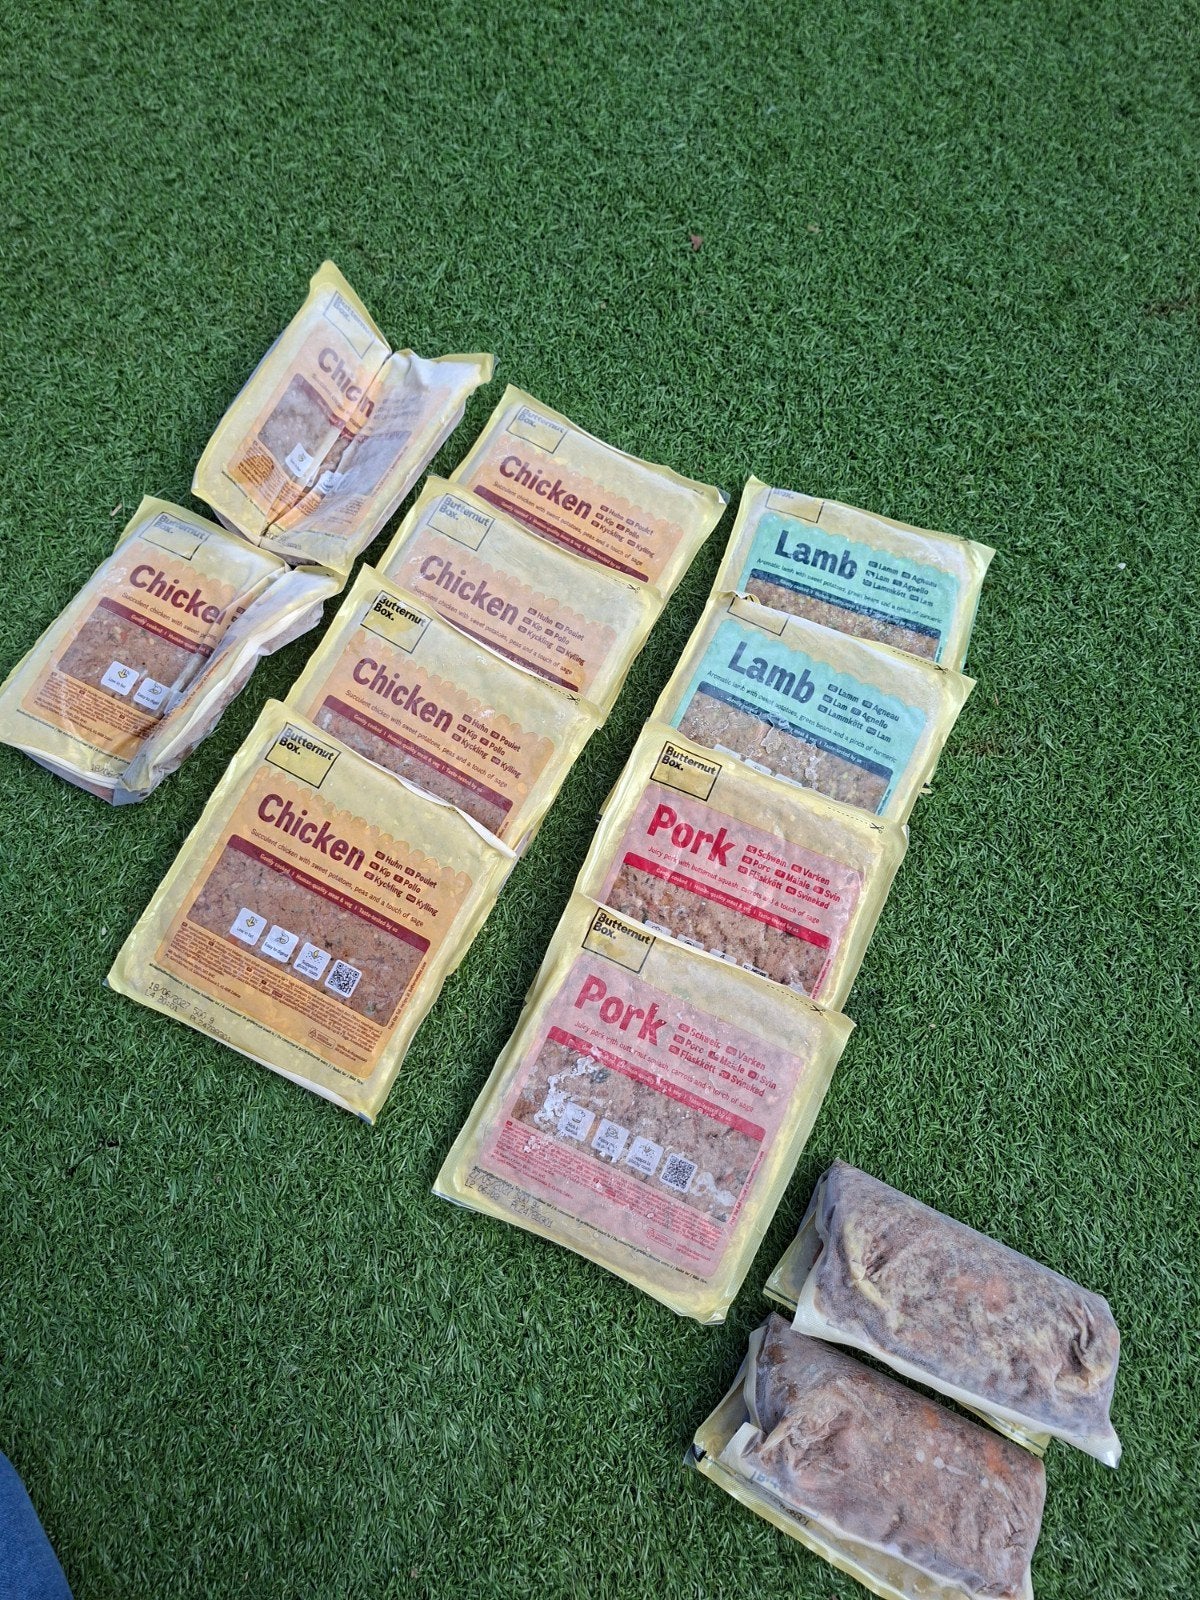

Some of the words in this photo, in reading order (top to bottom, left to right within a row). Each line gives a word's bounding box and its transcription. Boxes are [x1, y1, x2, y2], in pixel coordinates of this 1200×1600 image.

[317, 347, 375, 418] Chicn
[499, 455, 592, 519] Chicken
[438, 504, 461, 520] Box.
[443, 496, 490, 527] Butternut
[603, 516, 615, 527] Kip
[598, 523, 625, 542] Kyckling
[774, 530, 858, 579] Lamb
[878, 563, 899, 575] Lamm
[418, 555, 519, 626] Chicken
[148, 606, 171, 620] chicken
[373, 602, 397, 620] Box.
[377, 594, 427, 627] Butternut
[525, 629, 554, 649] Kyckling
[563, 649, 586, 667] Kylling
[530, 620, 544, 632] Kip
[553, 632, 570, 645] Pollo
[563, 625, 585, 641] Poulet
[558, 665, 572, 676] sage
[727, 641, 815, 704] Lamb
[352, 657, 453, 733] Chicken
[837, 688, 859, 703] Lamm
[871, 704, 900, 723] Agneau
[746, 688, 759, 697] with
[815, 722, 833, 733] beans
[831, 729, 844, 738] and
[848, 737, 865, 749] pinch
[827, 708, 863, 730] Lammkött
[875, 731, 892, 742] Lam
[832, 698, 849, 711] Lam
[860, 712, 888, 730] Agnello
[278, 736, 304, 755] Box.
[283, 727, 335, 760] Butternut
[344, 689, 371, 708] Succulent
[370, 704, 391, 719] chicken
[389, 715, 402, 726] with
[401, 722, 417, 735] sweet
[441, 746, 455, 758] peas
[455, 753, 467, 763] and
[470, 762, 487, 775] touch
[492, 777, 508, 789] sage
[464, 729, 478, 741] Kip
[487, 742, 506, 756] Pollo
[470, 719, 490, 733] Huhn
[498, 735, 522, 752] Poulet
[459, 738, 489, 759] Kyckling
[498, 761, 522, 779] Kylling
[661, 754, 685, 771] Box.
[664, 745, 717, 775] Butternut
[258, 794, 366, 871] Chicken
[646, 803, 736, 866] Pork
[250, 828, 278, 847] Succulent
[277, 842, 299, 858] chicken
[298, 854, 311, 865] with
[310, 862, 328, 874] sweet
[327, 871, 355, 890] potatoes,
[353, 885, 368, 897] peas
[367, 893, 380, 903] and
[384, 902, 402, 914] touch
[401, 910, 410, 918] of
[409, 916, 424, 928] sage
[377, 865, 392, 878] Kip
[402, 879, 422, 893] Pollo
[384, 855, 404, 870] Huhn
[414, 871, 438, 888] Poulet
[647, 846, 663, 858] Juicy
[677, 859, 690, 868] with
[690, 864, 717, 880] butternut
[779, 902, 797, 914] touch
[752, 859, 771, 872] Porc
[785, 873, 811, 889] Maiale
[823, 889, 841, 902] Svin
[756, 848, 788, 867] Schwein
[801, 868, 830, 885] Varken
[372, 875, 404, 897] Kyckling
[414, 898, 439, 916] Kylling
[796, 889, 830, 909] Svinekød
[592, 920, 619, 939] Box.
[596, 911, 652, 944] Butternut
[574, 974, 667, 1046] Pork
[678, 1050, 717, 1073] Fläskkött
[683, 1038, 705, 1054] Porc
[759, 1075, 778, 1090] Svin
[736, 1050, 767, 1071] Varken
